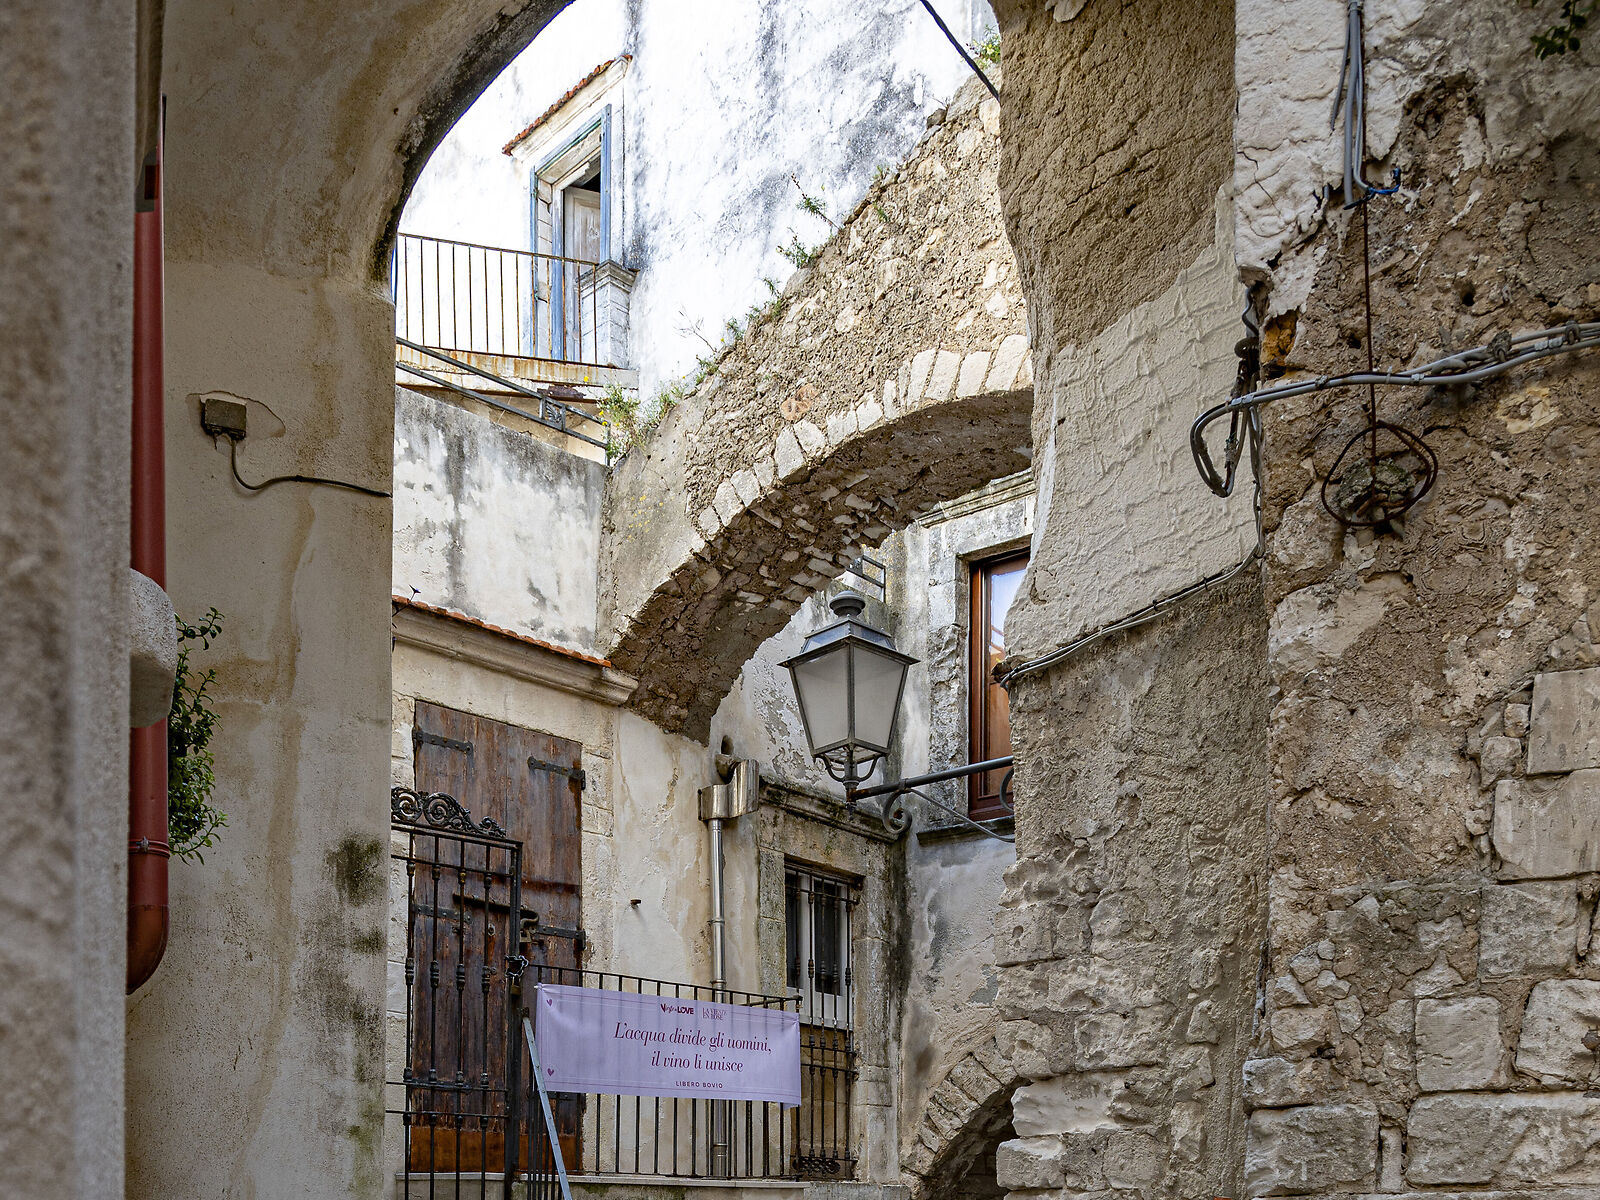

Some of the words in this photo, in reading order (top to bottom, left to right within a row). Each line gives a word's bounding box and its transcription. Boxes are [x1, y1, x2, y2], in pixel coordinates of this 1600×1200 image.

[677, 1006, 694, 1014] LOVE
[614, 1021, 665, 1047] L'acqua
[669, 1028, 706, 1047] divide
[709, 1032, 725, 1052] gli
[728, 1036, 772, 1055] uomini,
[651, 1050, 661, 1067] il
[663, 1052, 690, 1069] vino
[694, 1053, 702, 1070] li
[705, 1055, 744, 1072] unisce
[675, 1080, 700, 1088] LIBERO
[702, 1081, 723, 1089] BOVIO
